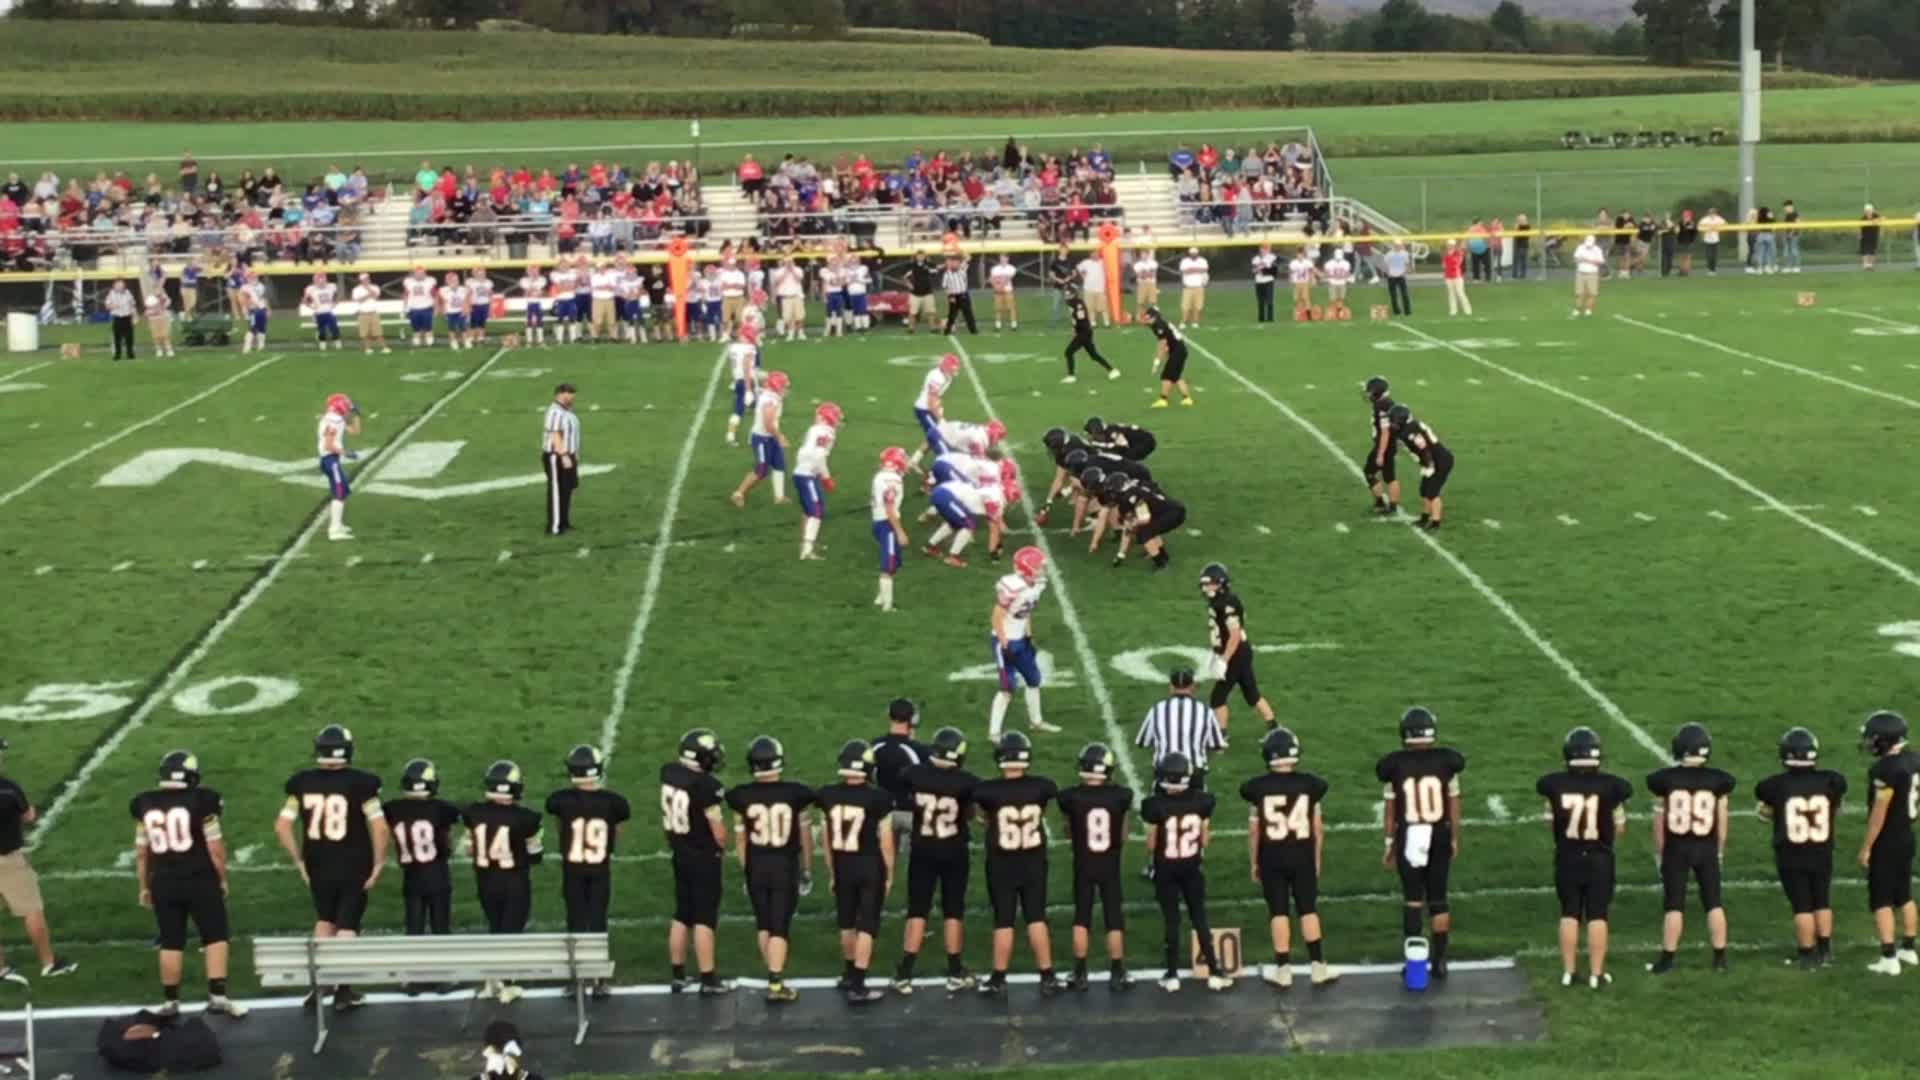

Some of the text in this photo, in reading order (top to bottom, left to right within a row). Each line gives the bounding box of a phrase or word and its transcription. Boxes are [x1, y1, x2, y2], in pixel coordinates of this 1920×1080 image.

[303, 794, 348, 841] 78
[660, 783, 690, 834] 58
[916, 793, 960, 839] 72
[1264, 794, 1310, 841] 54
[1403, 776, 1445, 823] 10
[1561, 794, 1600, 840] 71
[1668, 790, 1716, 836] 89
[1785, 795, 1830, 843] 63
[144, 806, 193, 854] 60
[395, 820, 438, 864] 18
[473, 824, 515, 869] 14
[568, 817, 609, 864] 19
[746, 803, 793, 847] 30
[829, 804, 864, 851] 17
[998, 805, 1043, 850] 62
[1087, 807, 1111, 852] 8
[1164, 814, 1200, 859] 12
